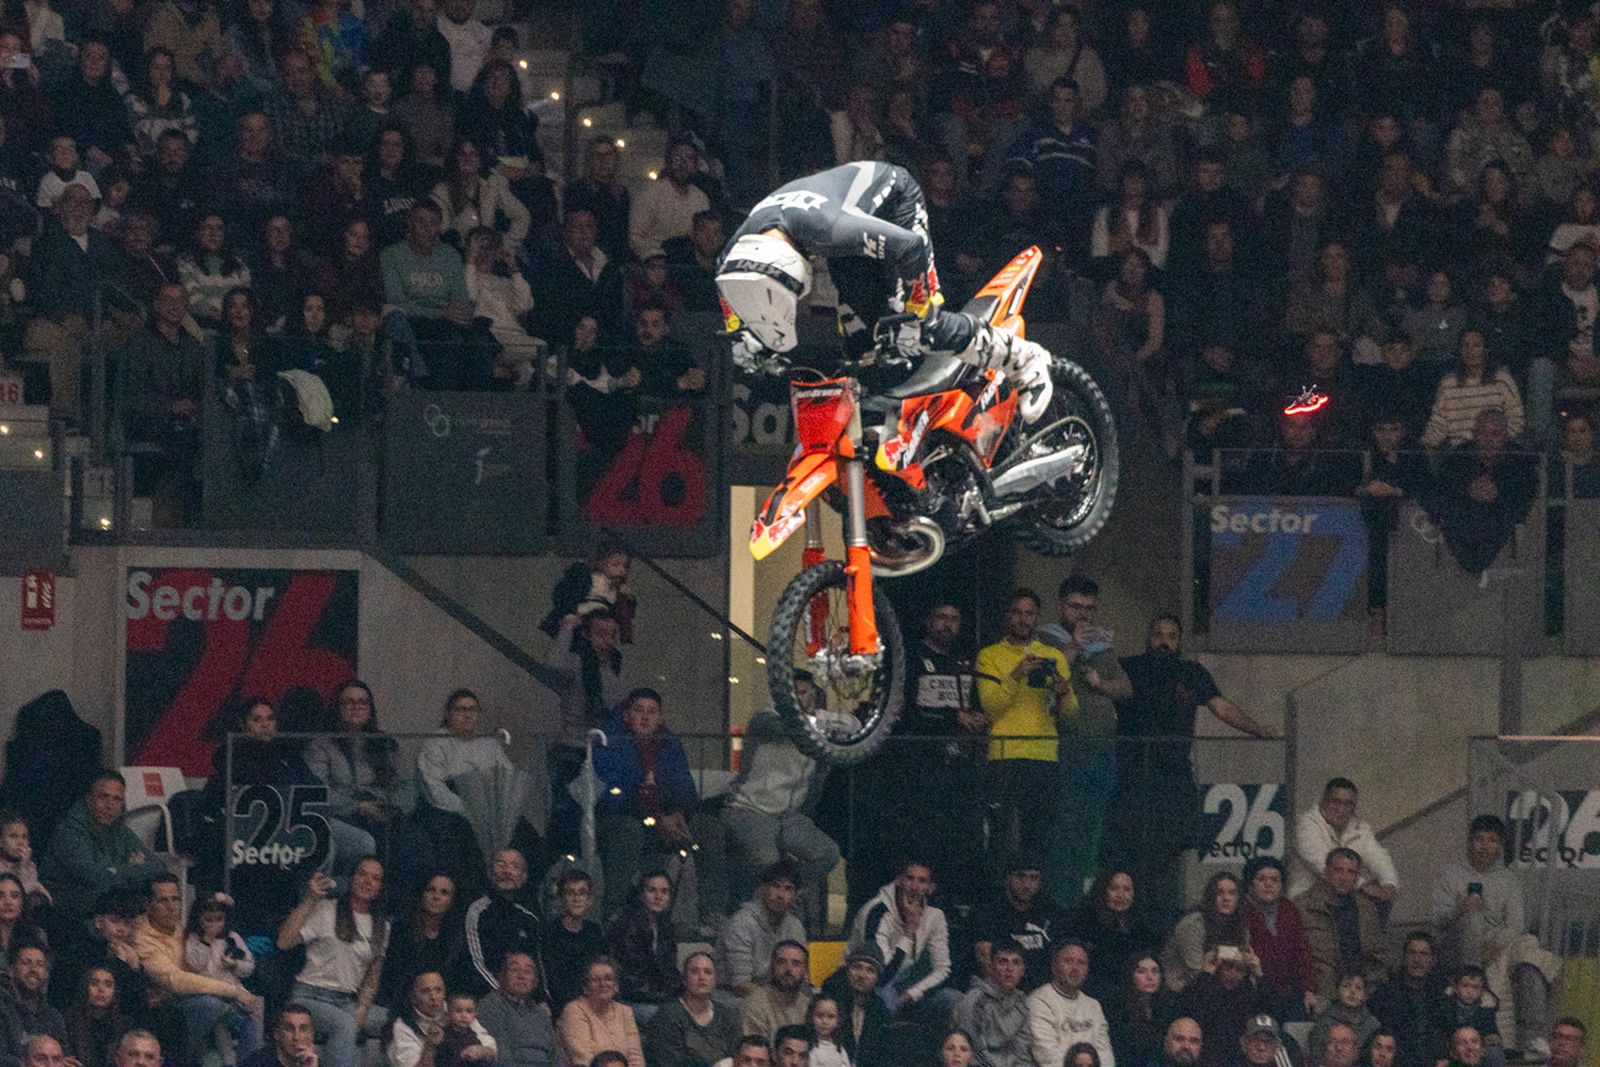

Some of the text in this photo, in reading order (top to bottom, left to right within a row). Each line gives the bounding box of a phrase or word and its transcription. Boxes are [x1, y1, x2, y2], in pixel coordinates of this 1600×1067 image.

[1210, 504, 1320, 534] Sector
[1211, 499, 1369, 624] 27
[126, 570, 275, 621] Sector
[231, 839, 306, 865] Sector
[233, 784, 335, 872] 25
[1203, 783, 1285, 864] 26
